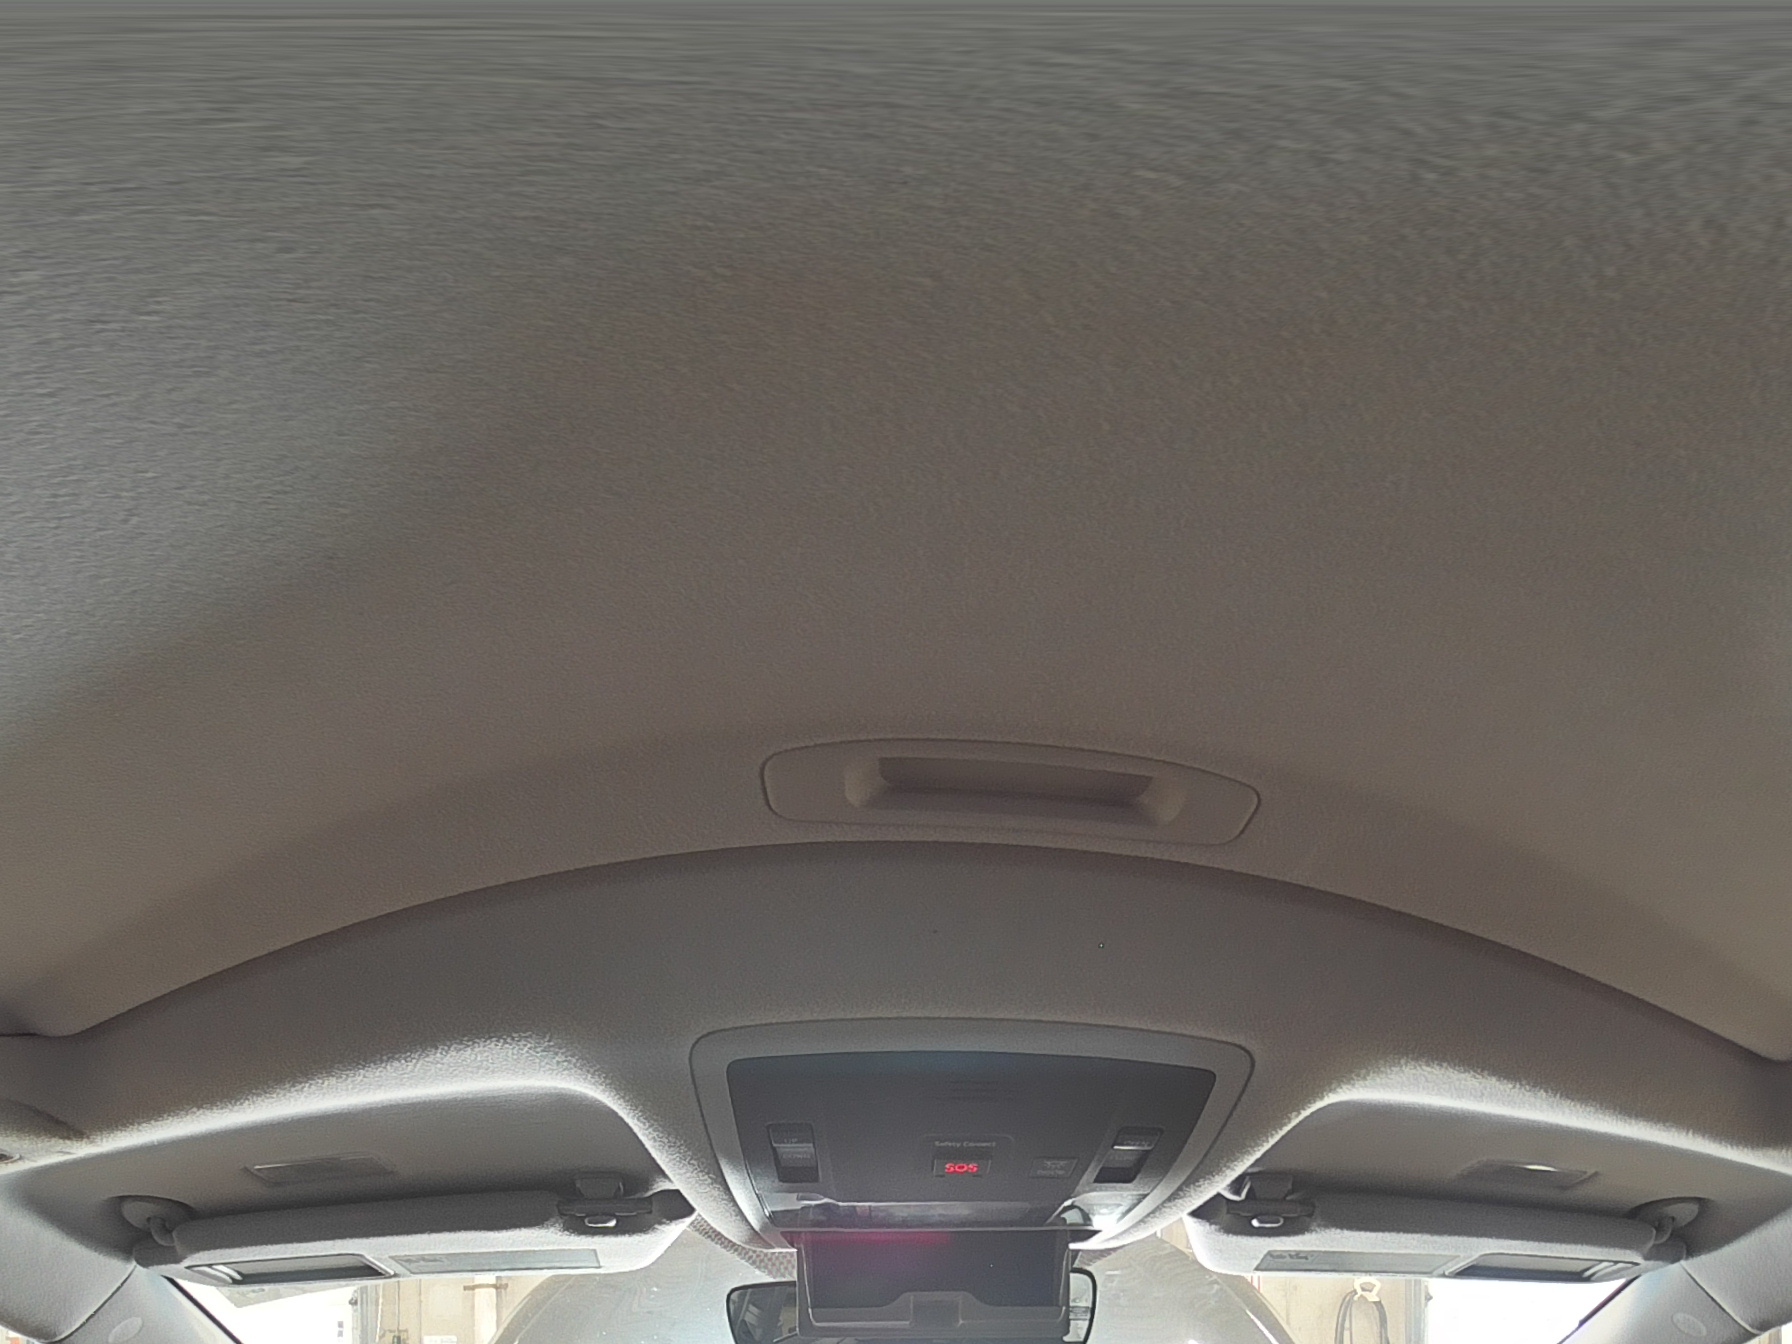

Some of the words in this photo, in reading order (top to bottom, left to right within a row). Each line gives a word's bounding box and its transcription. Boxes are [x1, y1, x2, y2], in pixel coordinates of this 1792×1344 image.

[934, 1140, 961, 1148] Safety
[963, 1140, 996, 1148] Connect
[944, 1162, 979, 1174] SOS
